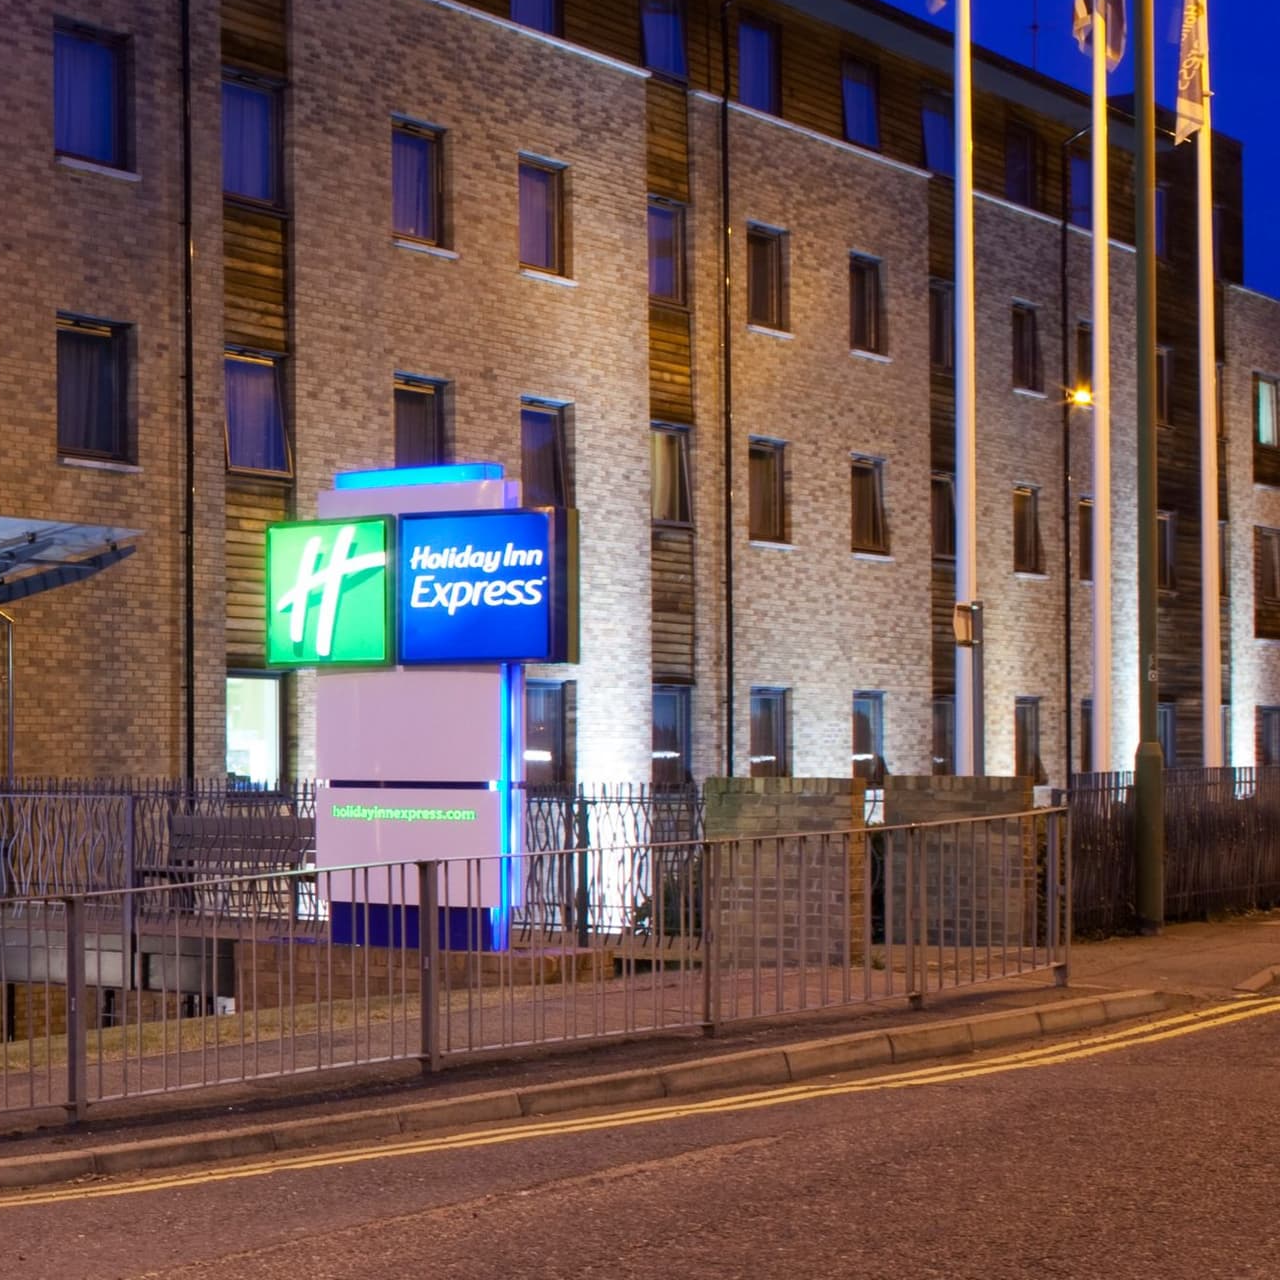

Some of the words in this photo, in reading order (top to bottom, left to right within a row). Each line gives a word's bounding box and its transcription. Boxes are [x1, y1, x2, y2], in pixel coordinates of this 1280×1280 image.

[409, 544, 502, 574] Holiday
[503, 542, 544, 567] Inn
[410, 574, 544, 617] Express
[332, 804, 477, 822] holidayinnexpress.com
